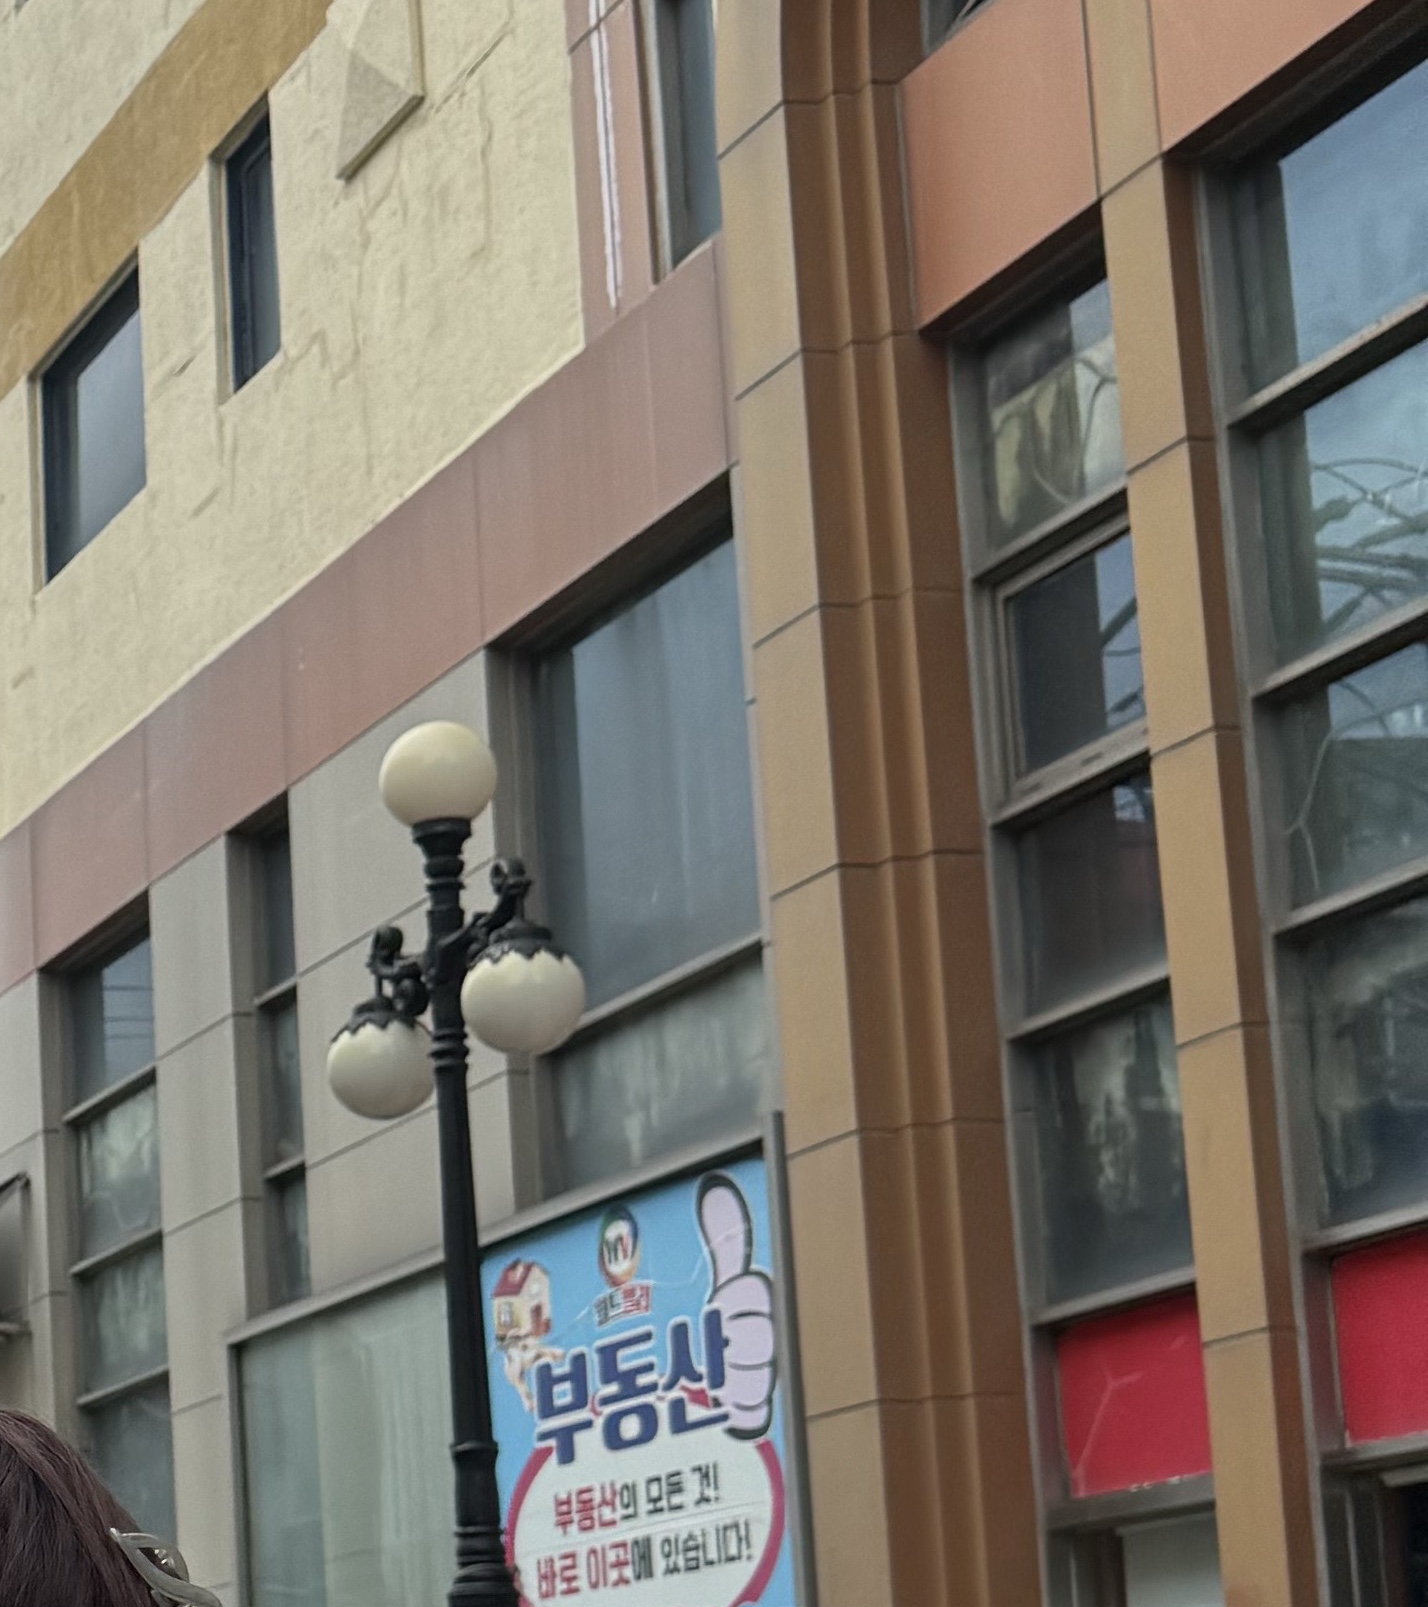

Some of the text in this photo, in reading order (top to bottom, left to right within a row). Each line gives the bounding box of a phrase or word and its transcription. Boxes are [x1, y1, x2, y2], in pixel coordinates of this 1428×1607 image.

[536, 1308, 730, 1465] 부동산
[554, 1461, 720, 1535] 부동산의 모든 것!
[537, 1518, 753, 1599] 바로 이곳에 있습니다!
